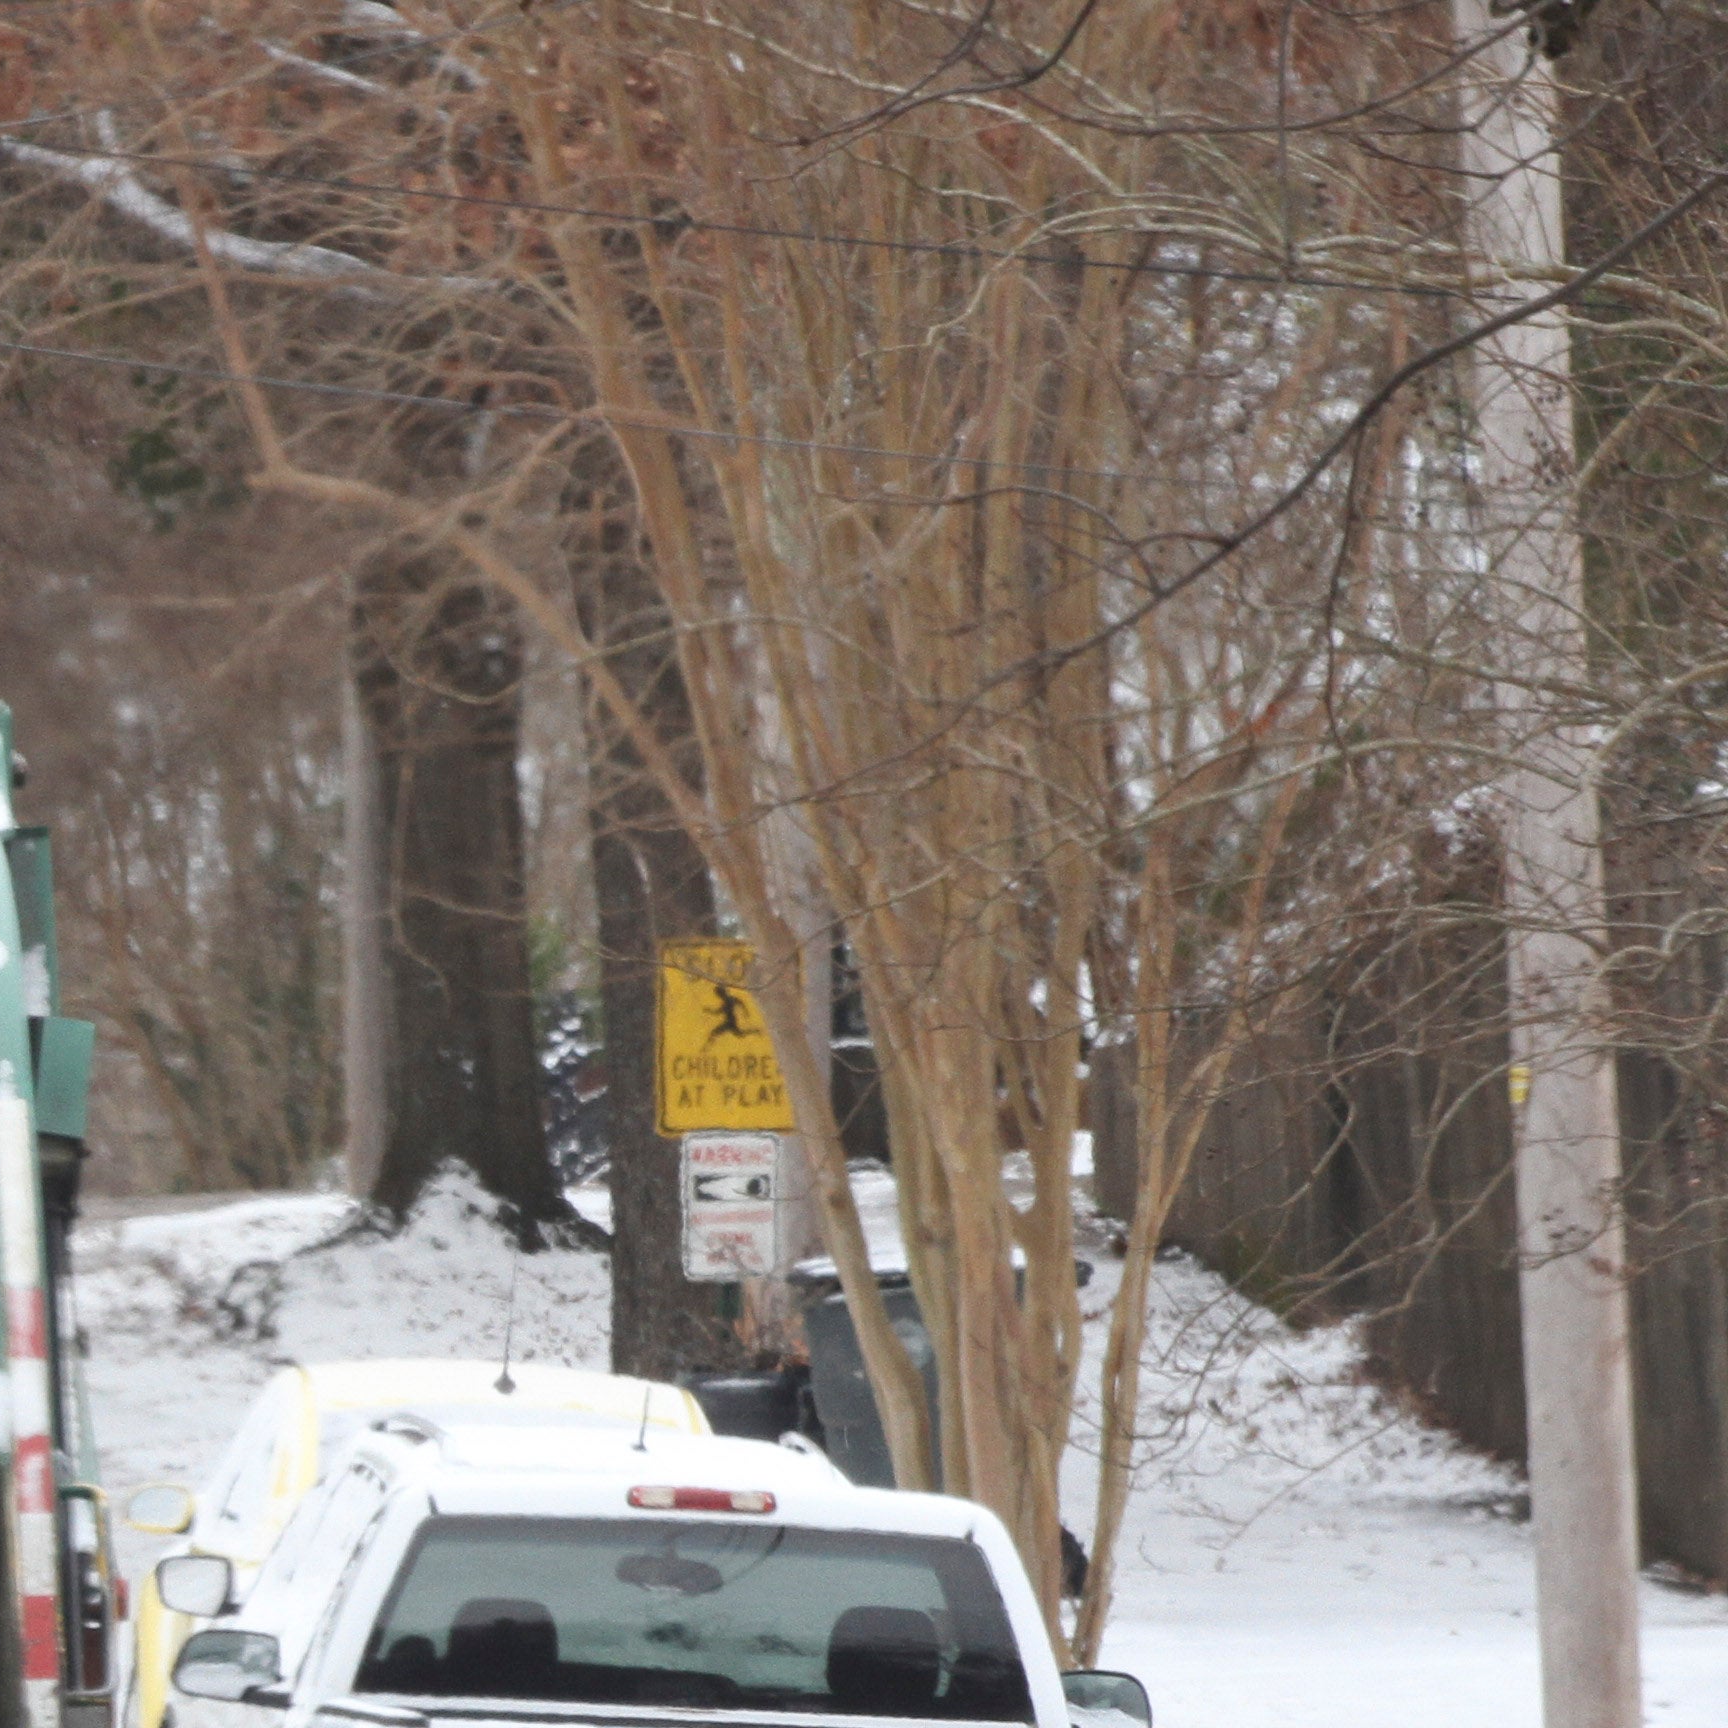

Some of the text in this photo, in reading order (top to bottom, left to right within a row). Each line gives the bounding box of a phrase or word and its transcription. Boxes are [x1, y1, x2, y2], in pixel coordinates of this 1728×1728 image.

[672, 1055, 783, 1080] CHILDRE
[678, 1084, 782, 1108] AT PLAY
